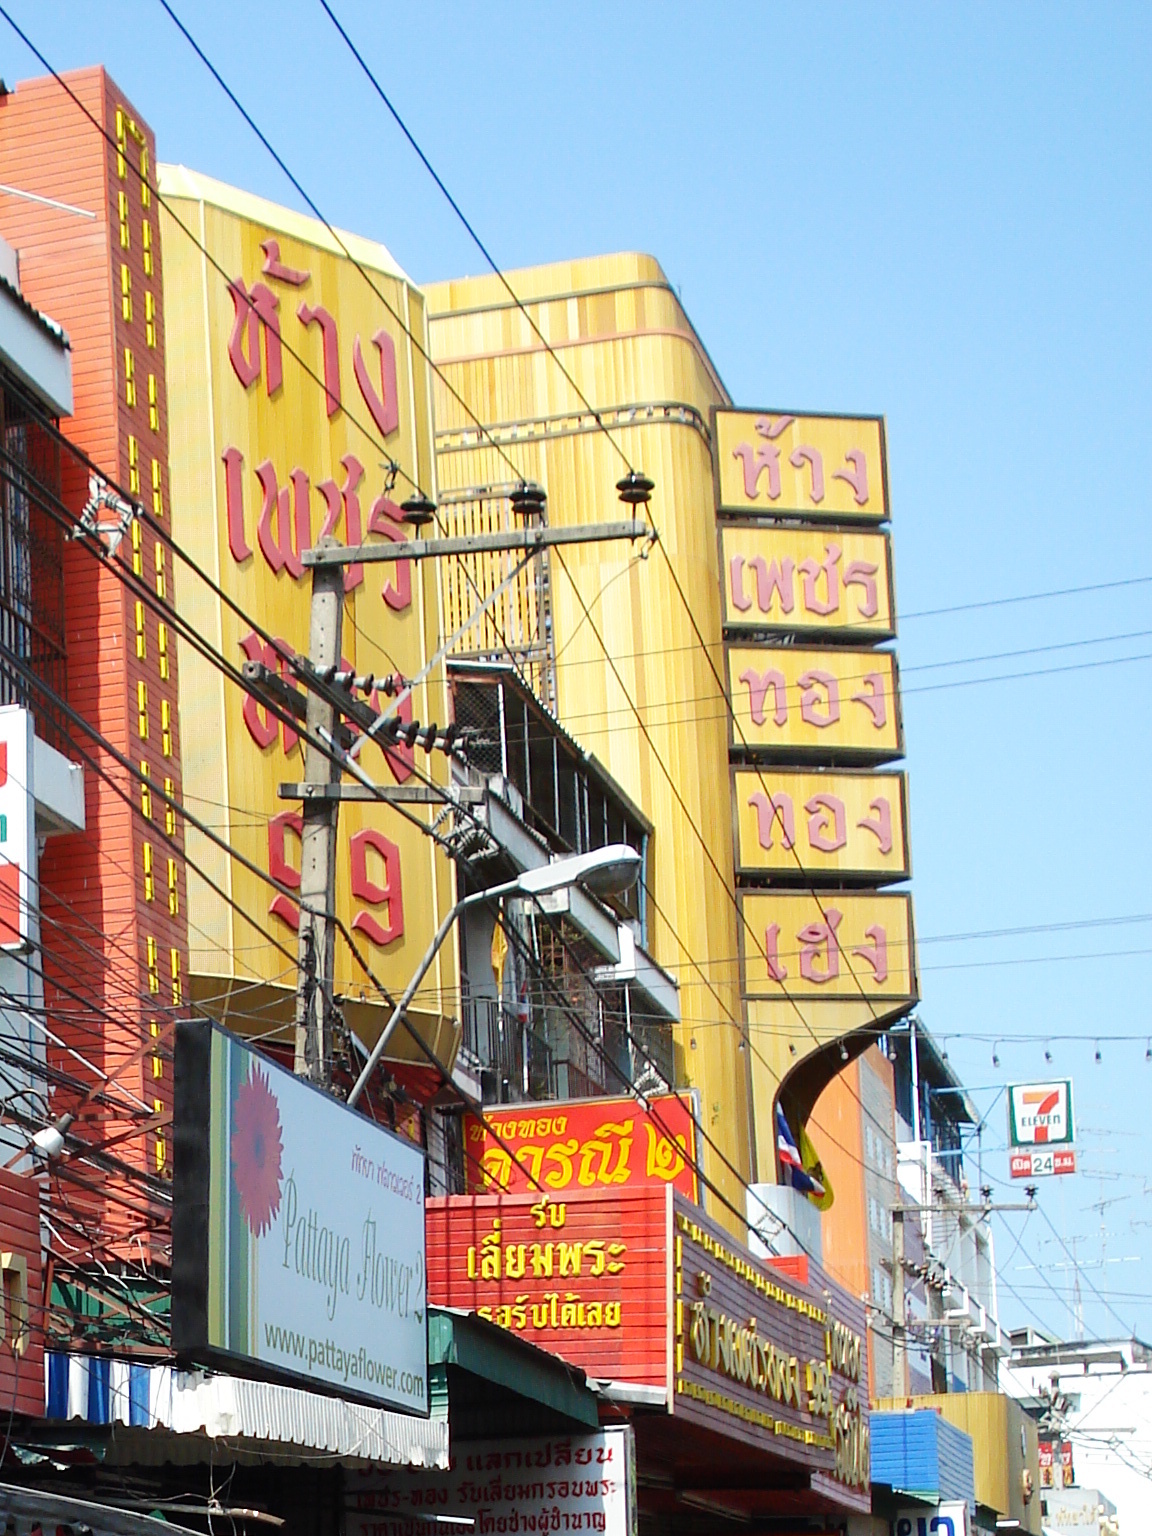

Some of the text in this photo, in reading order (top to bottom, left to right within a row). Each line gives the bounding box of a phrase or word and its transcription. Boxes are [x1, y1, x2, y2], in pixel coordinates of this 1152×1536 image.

[226, 239, 399, 437] ห้าง
[732, 415, 870, 506] ห้าง
[221, 445, 413, 612] เพชร
[729, 543, 880, 619] เพชร
[238, 630, 416, 785] ทง
[739, 666, 887, 729] ทอง
[749, 790, 894, 855] ทอง
[765, 907, 889, 985] เฮง
[1033, 1156, 1053, 1173] 24
[283, 1168, 350, 1321] Pattaya
[467, 1218, 627, 1281] เลี่ยมพระ
[530, 1194, 567, 1229] รับ
[264, 1322, 425, 1398] www.pattayaflower.com
[466, 1439, 614, 1473] แลกเปลี่ยน
